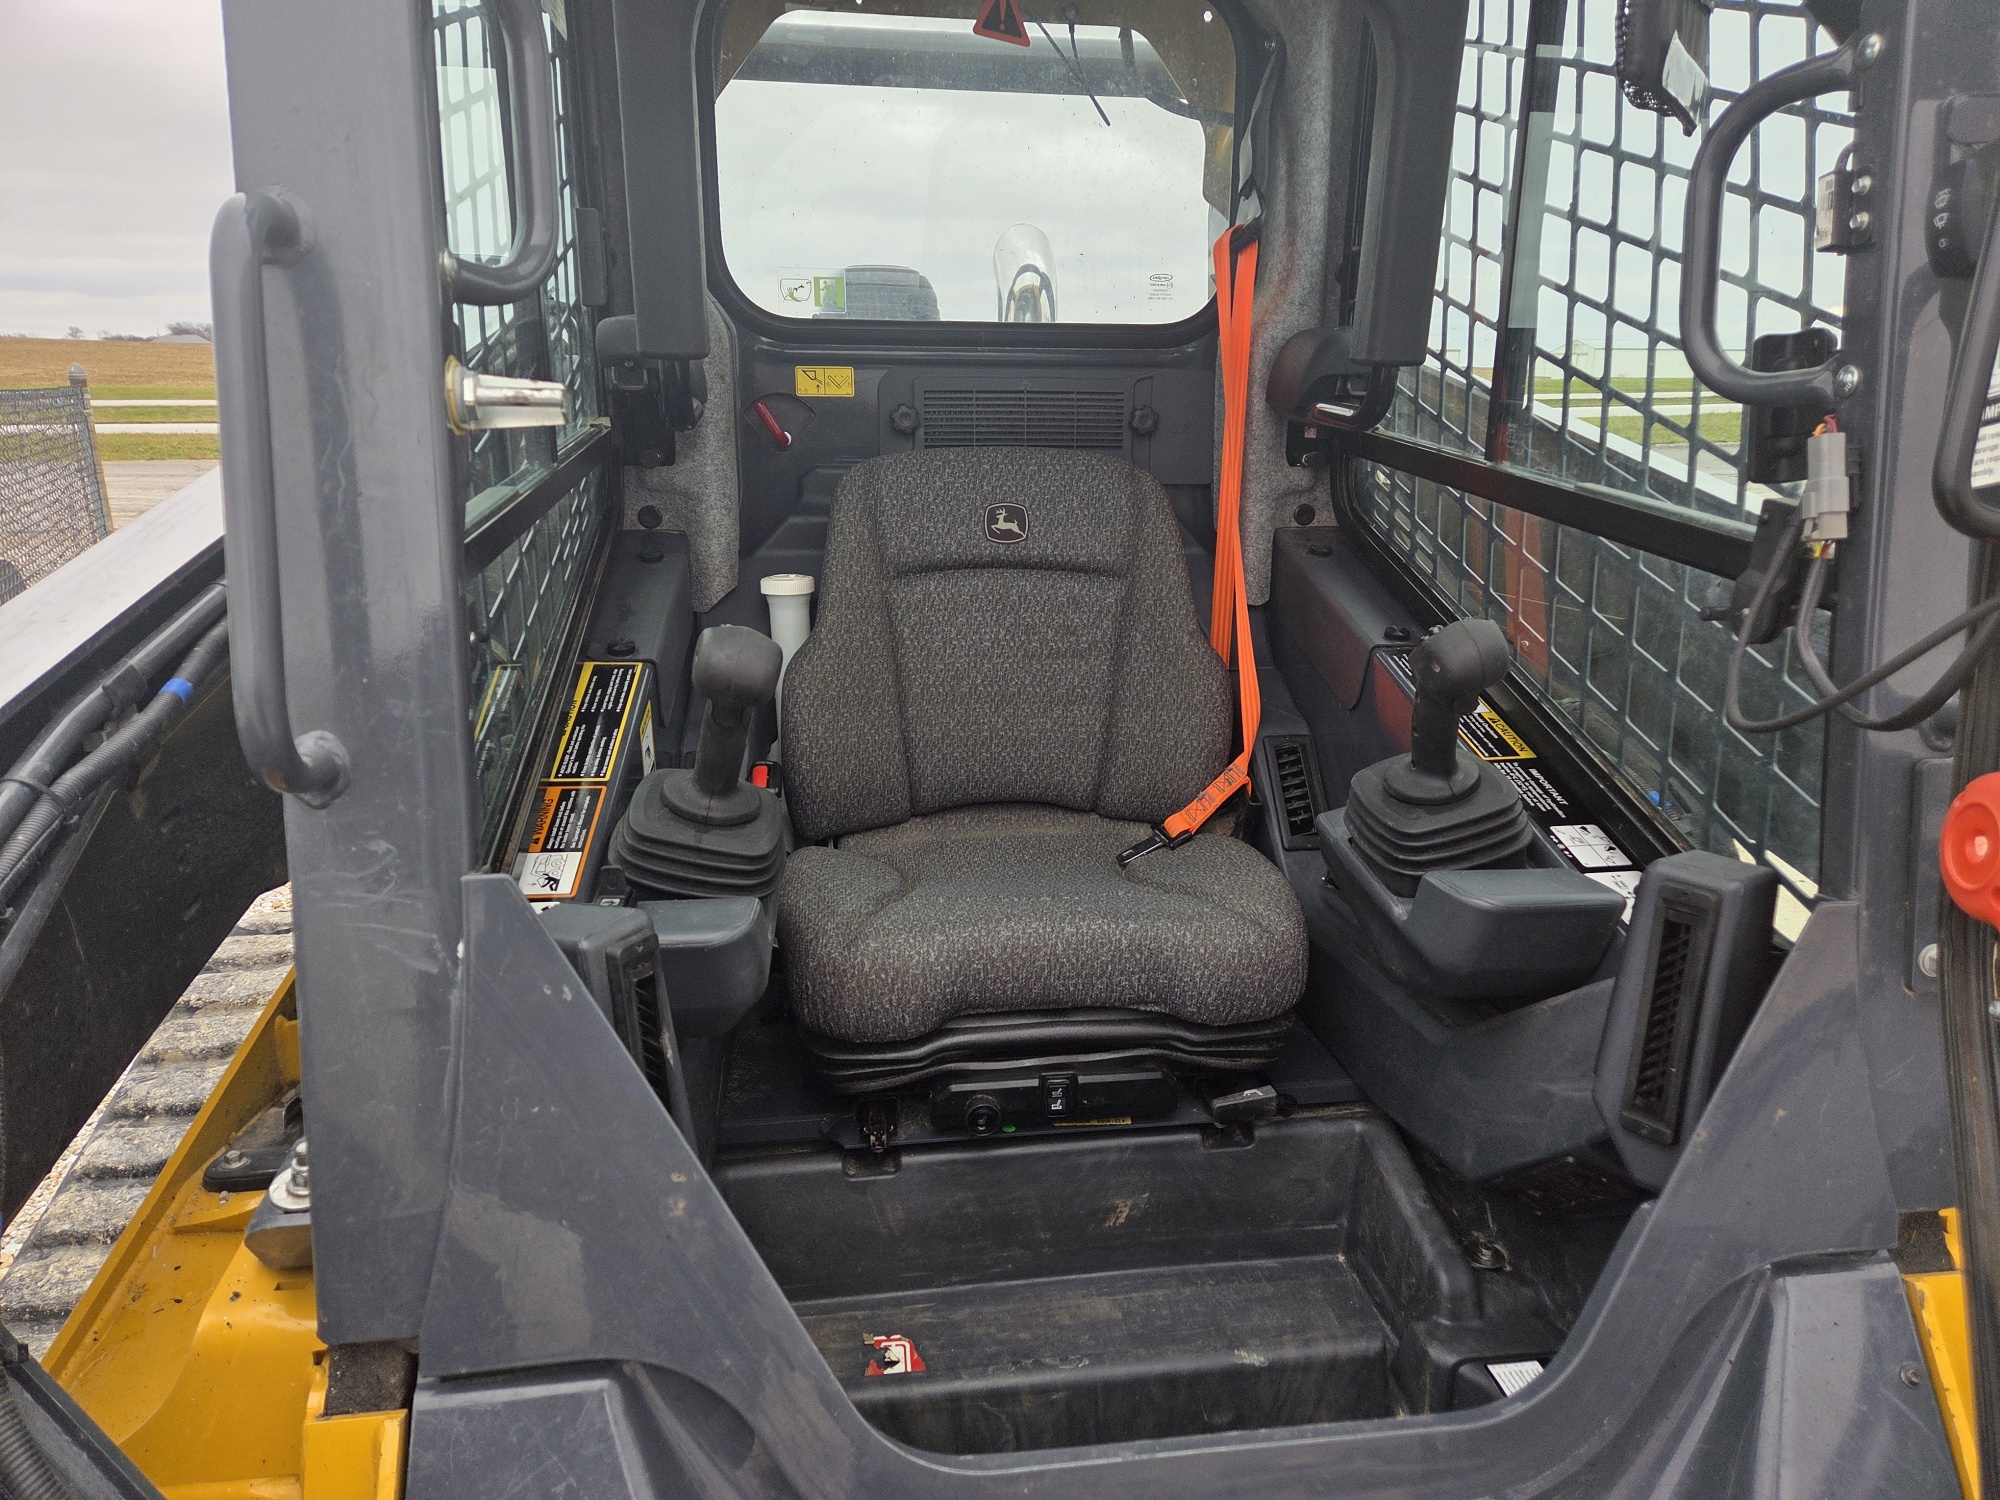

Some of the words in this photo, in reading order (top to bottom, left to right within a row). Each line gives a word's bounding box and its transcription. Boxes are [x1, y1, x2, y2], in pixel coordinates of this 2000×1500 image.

[1495, 720, 1528, 752] CAUTION
[1529, 769, 1569, 806] IMPORTANT
[535, 798, 554, 835] WARNING
